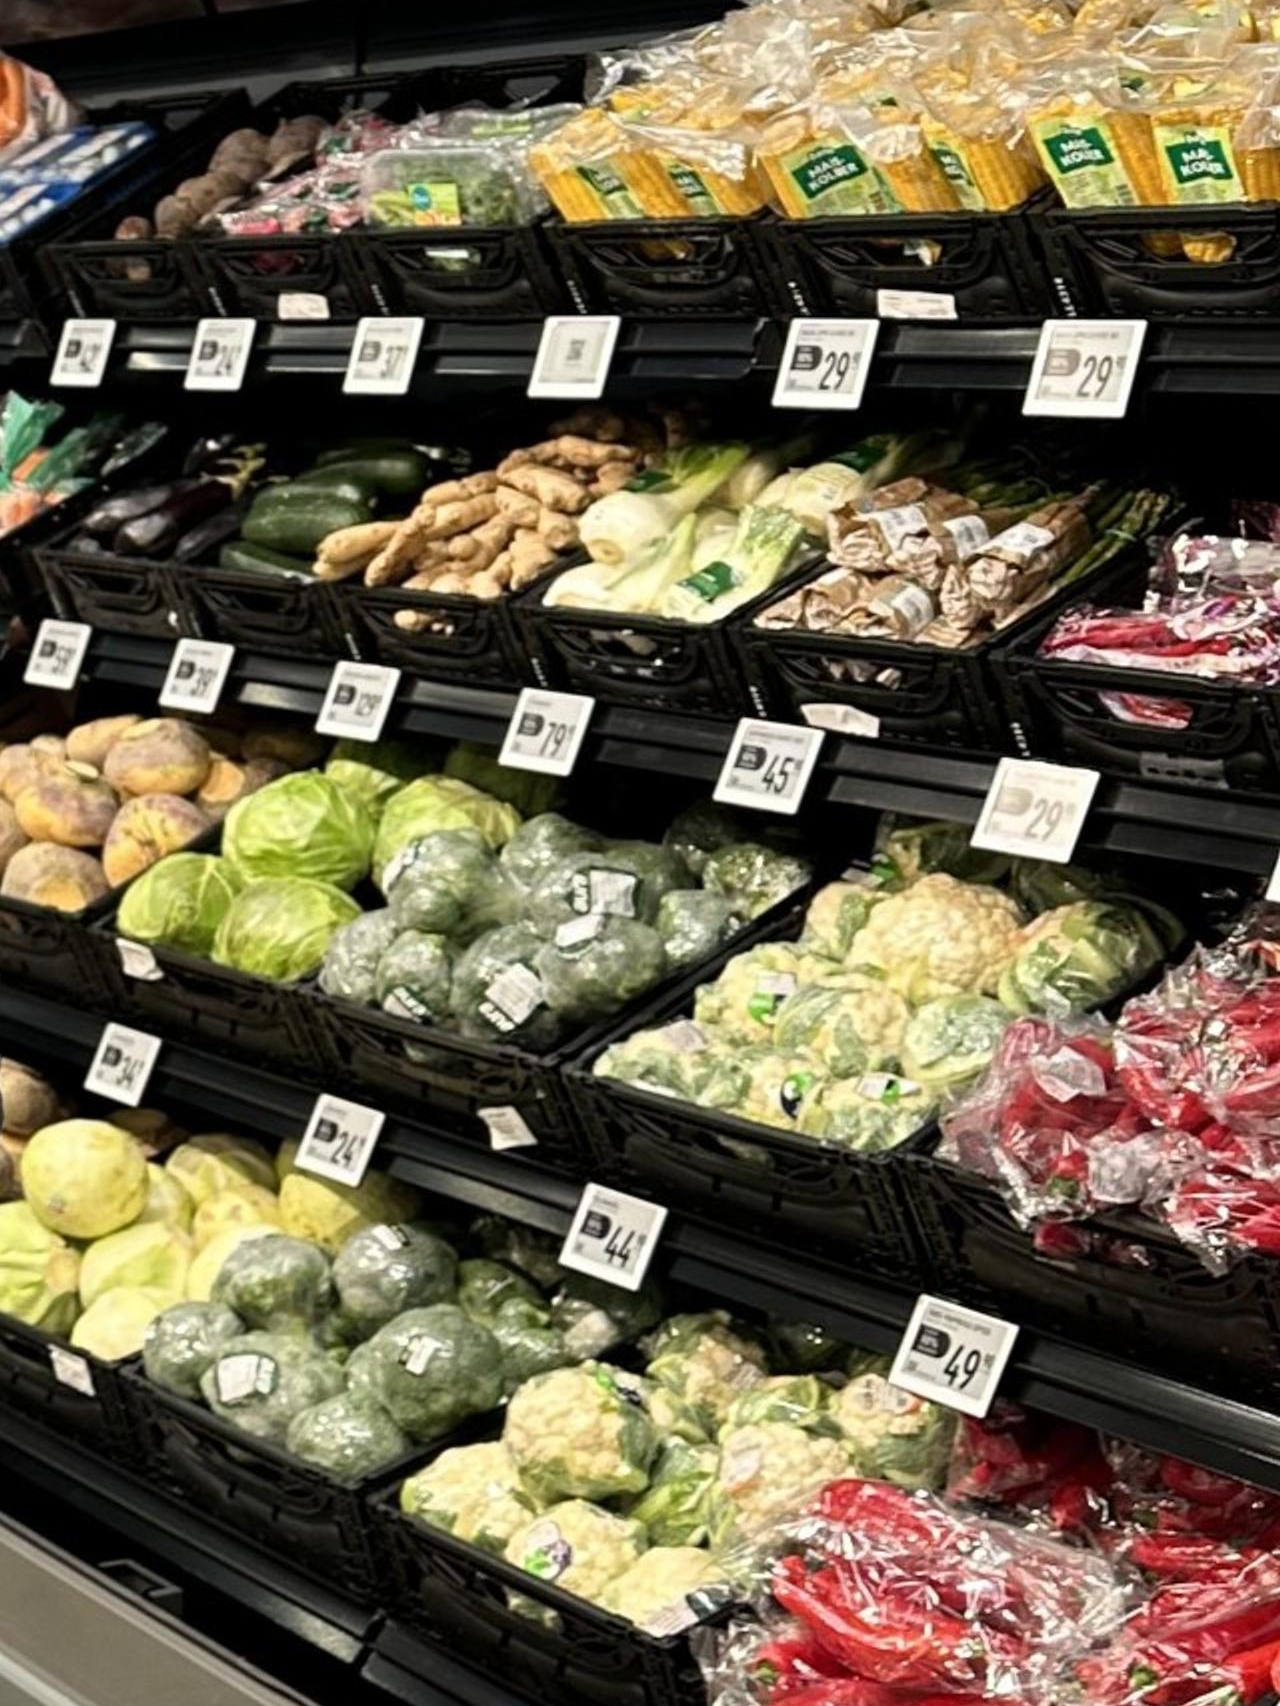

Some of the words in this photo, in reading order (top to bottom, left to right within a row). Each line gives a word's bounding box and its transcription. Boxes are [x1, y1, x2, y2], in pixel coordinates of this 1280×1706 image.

[819, 351, 851, 391] 29
[1075, 355, 1114, 399] 29
[539, 721, 568, 758] 79
[761, 754, 795, 794] 45
[1024, 797, 1064, 842] 29
[604, 1225, 635, 1269] 44
[943, 1344, 982, 1391] 49
